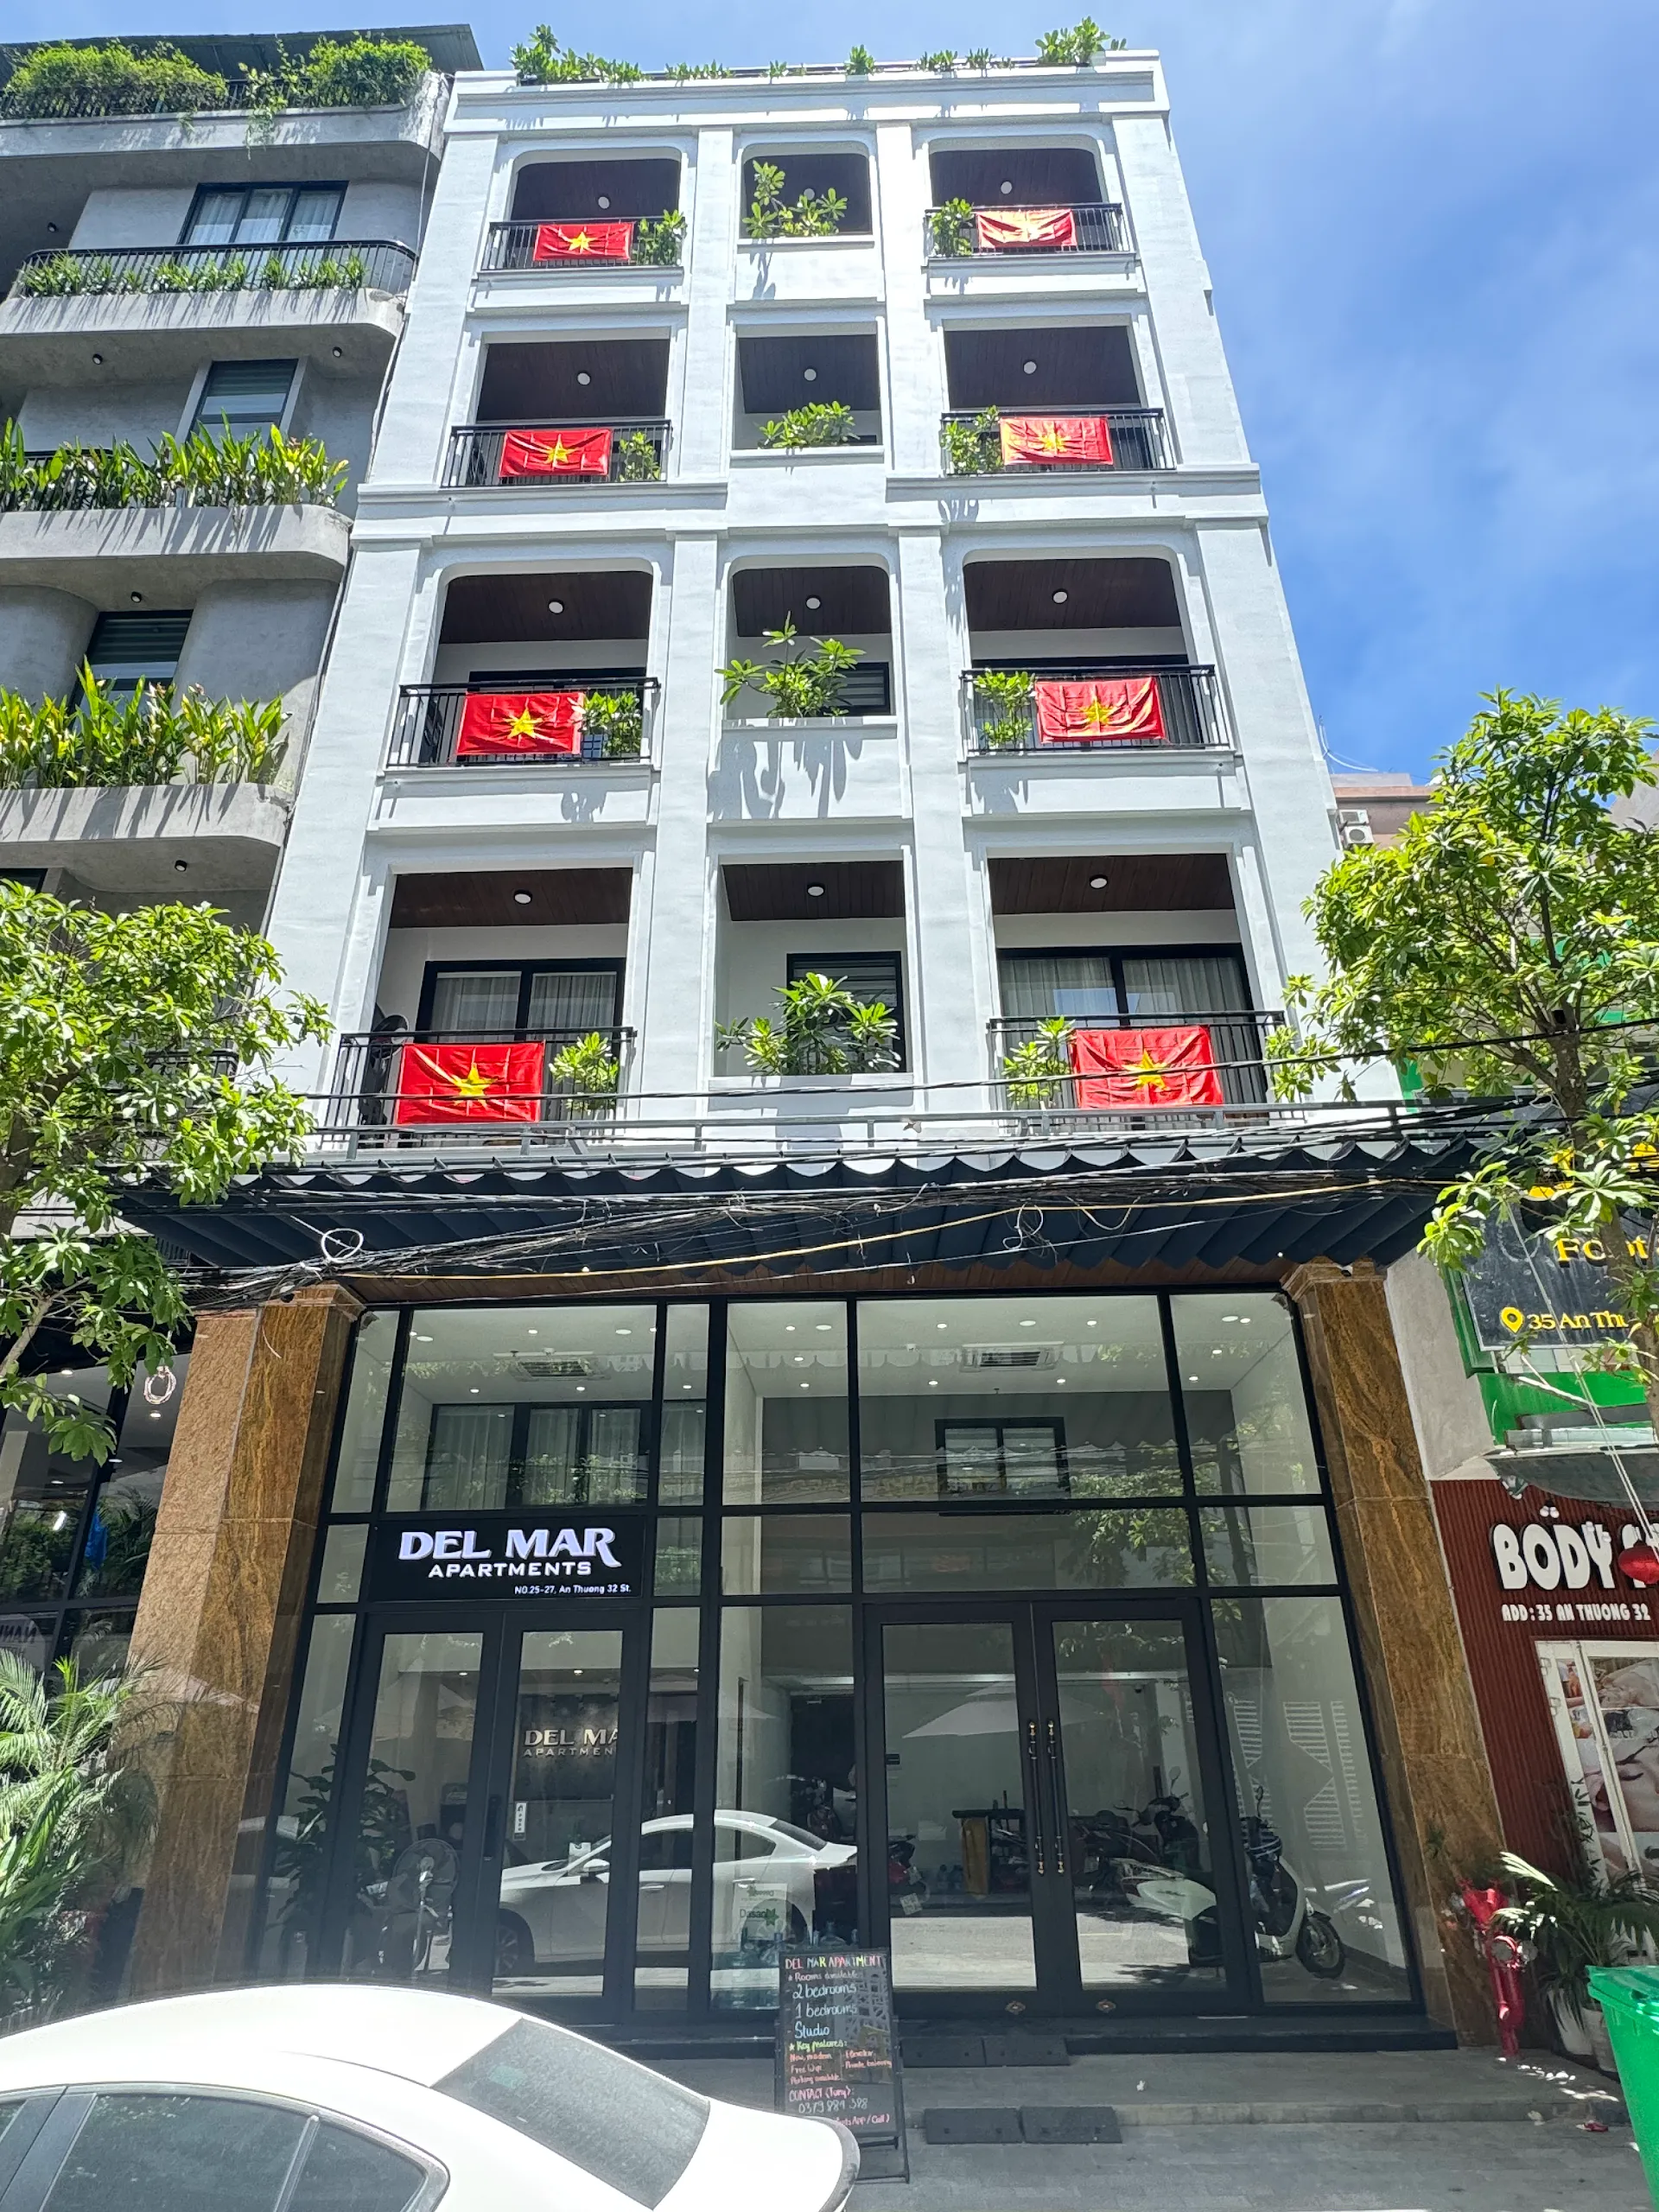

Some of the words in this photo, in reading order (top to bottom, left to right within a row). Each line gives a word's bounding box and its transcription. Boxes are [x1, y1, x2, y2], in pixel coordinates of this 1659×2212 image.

[1527, 1313, 1556, 1330] 35
[1559, 1313, 1592, 1329] An
[398, 1530, 492, 1560] DEL
[505, 1528, 622, 1567] MAR
[1492, 1522, 1616, 1590] BODY
[429, 1561, 592, 1578] APARTMENTS
[558, 1584, 571, 1594] An
[607, 1584, 618, 1593] 32
[1535, 1604, 1554, 1622] 35
[1555, 1604, 1575, 1621] AN
[1576, 1603, 1630, 1621] THUONG
[1631, 1603, 1651, 1621] 32
[524, 1729, 575, 1745] DEL
[583, 1728, 619, 1745] MA
[523, 1747, 613, 1758] APARTMEN
[785, 1956, 804, 1970] DEL
[807, 1956, 827, 1968] MAR
[794, 2020, 830, 2038] Studio
[789, 2088, 823, 2102] CONTACT
